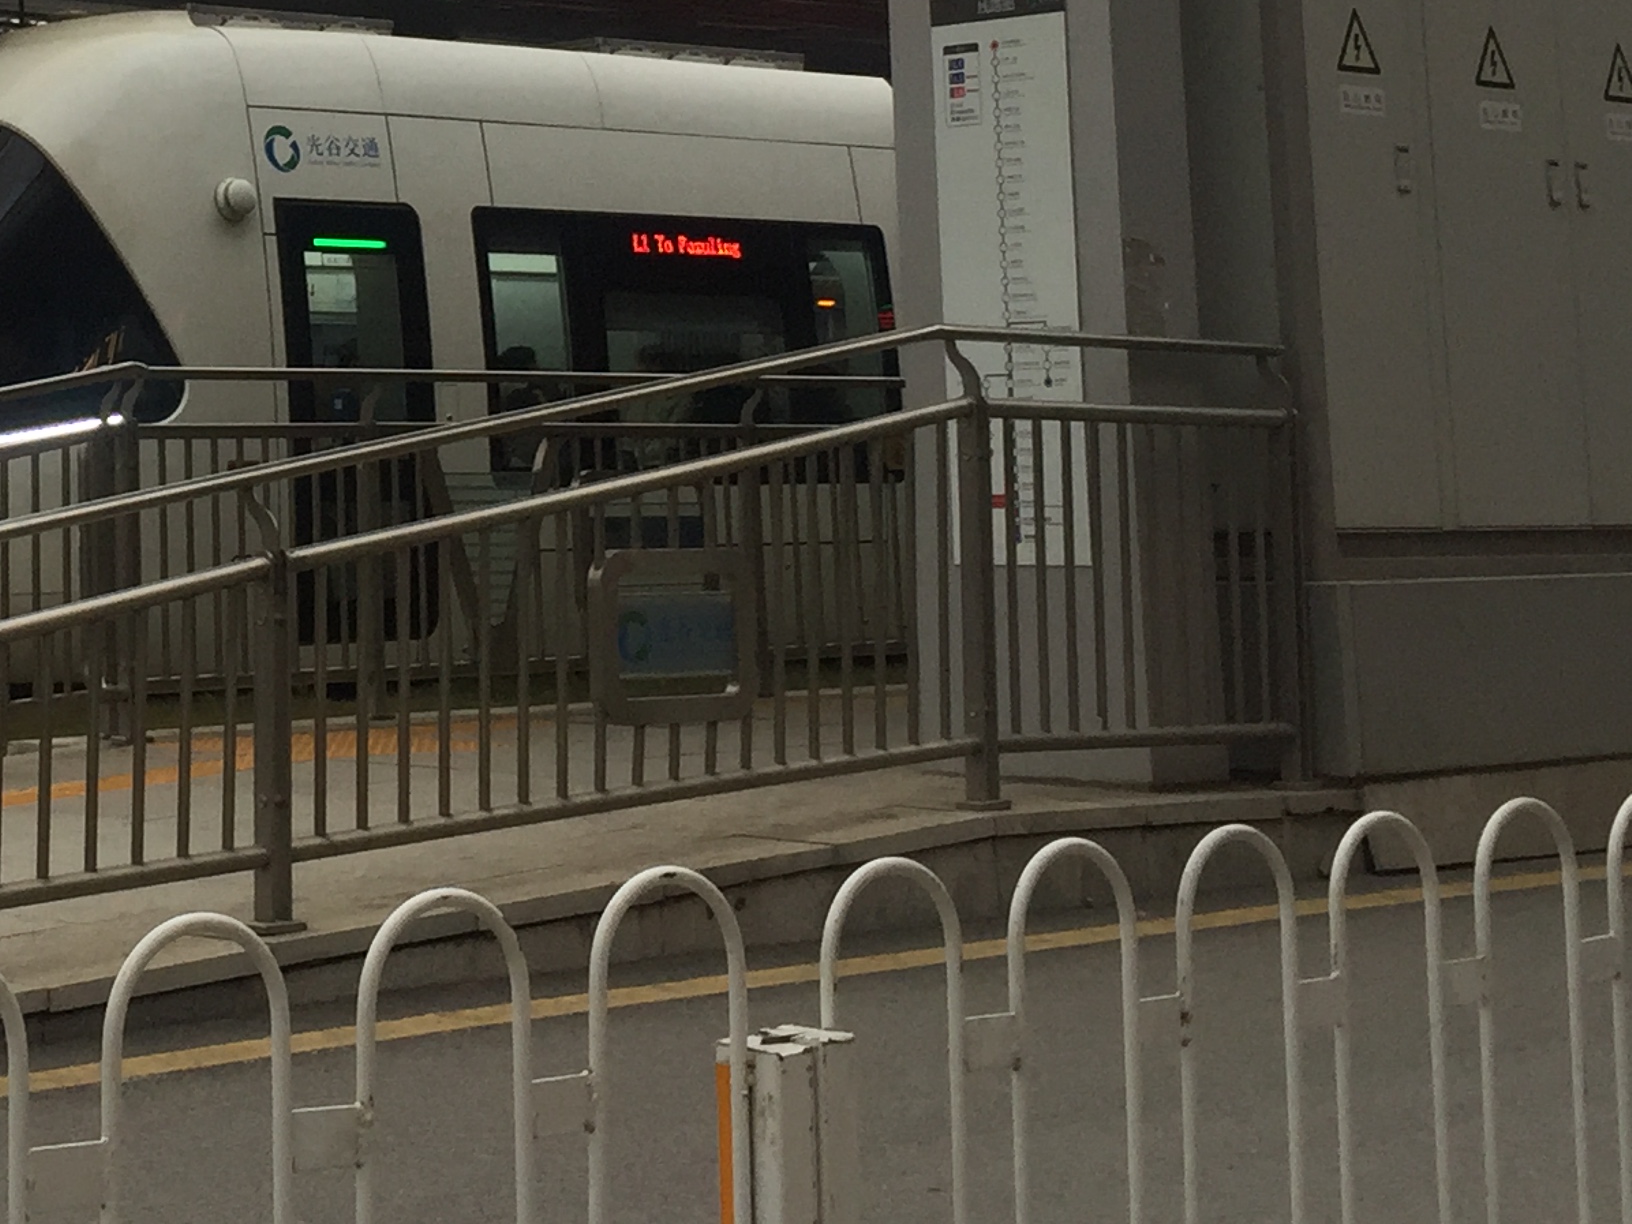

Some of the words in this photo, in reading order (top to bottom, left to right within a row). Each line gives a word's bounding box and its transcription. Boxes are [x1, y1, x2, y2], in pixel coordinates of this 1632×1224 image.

[306, 133, 380, 158] 光谷交通
[653, 234, 675, 254] To
